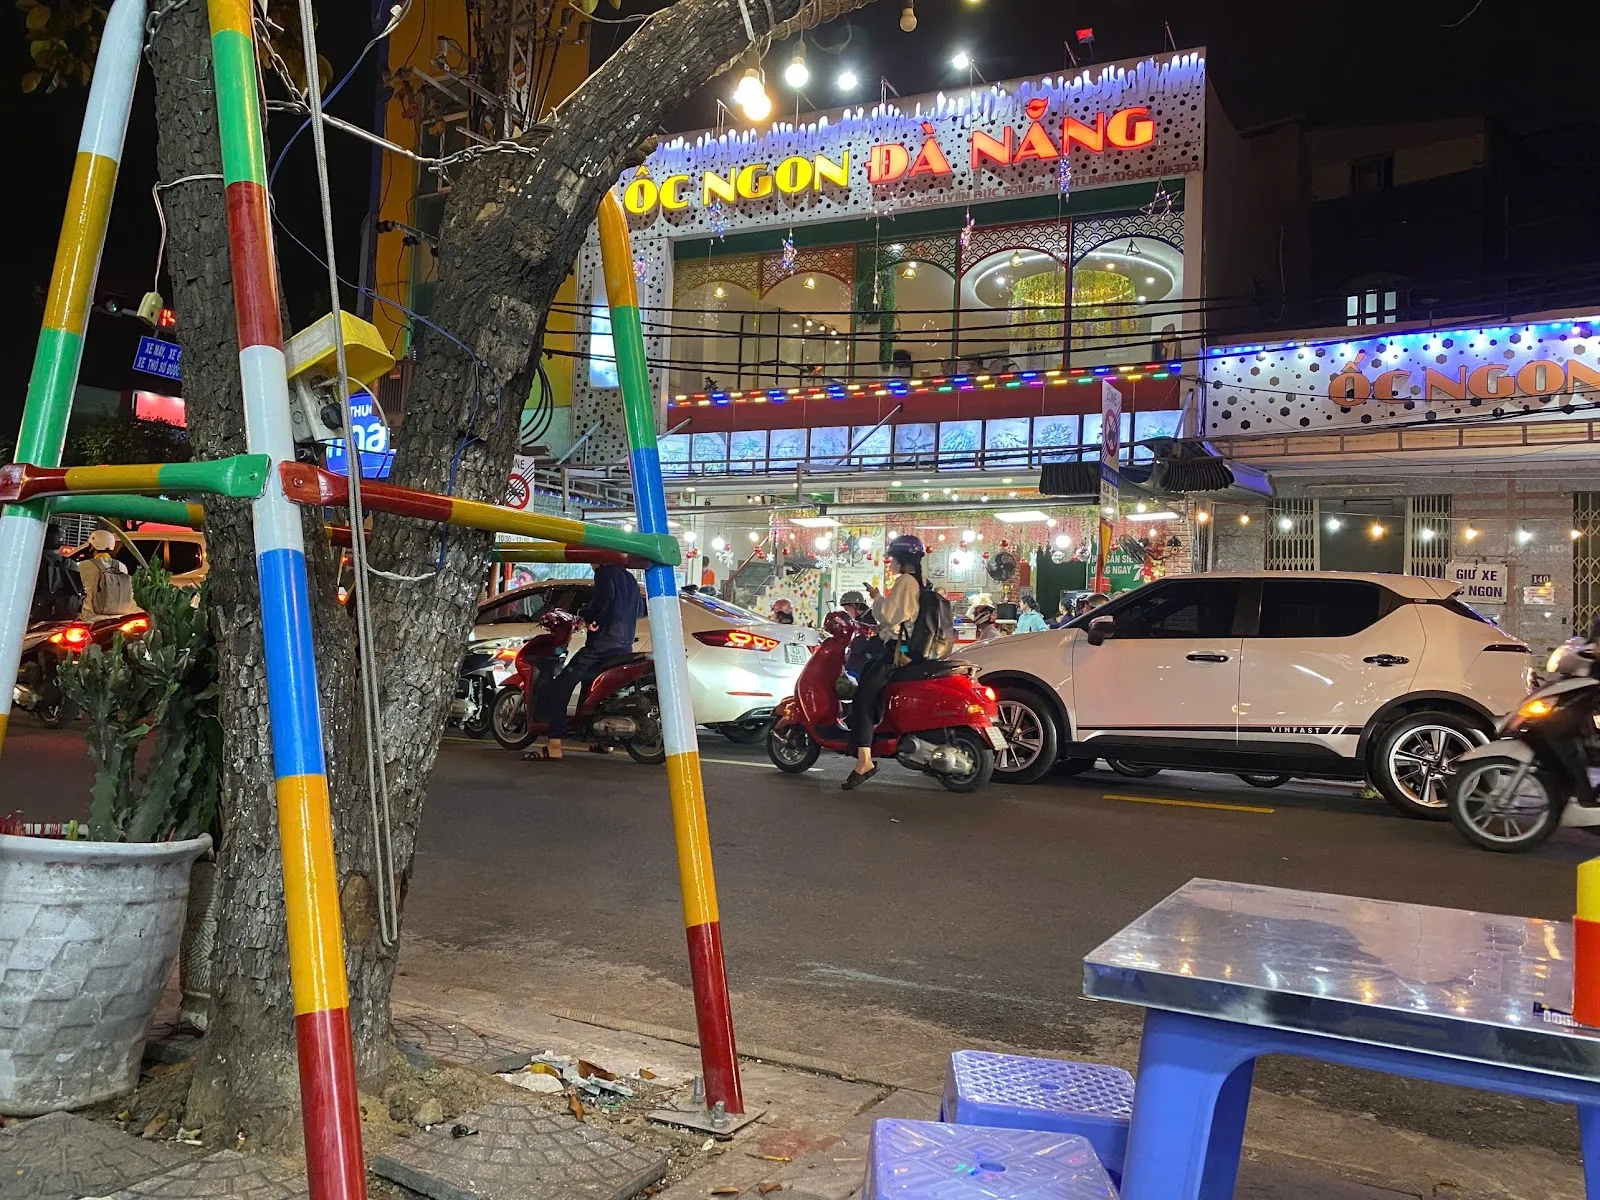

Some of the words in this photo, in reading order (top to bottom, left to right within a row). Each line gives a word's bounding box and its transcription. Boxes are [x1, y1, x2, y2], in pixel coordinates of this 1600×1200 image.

[703, 149, 850, 207] NGON
[864, 121, 953, 183] ĐÀ
[145, 342, 154, 355] XE
[168, 348, 177, 360] XE
[137, 356, 146, 369] XE
[1328, 352, 1412, 407] ỐC
[1112, 566, 1132, 575] NGAY
[1482, 570, 1498, 581] XE
[1533, 575, 1549, 583] 140
[1469, 586, 1503, 597] NGON
[1270, 726, 1321, 734] VINFAST
